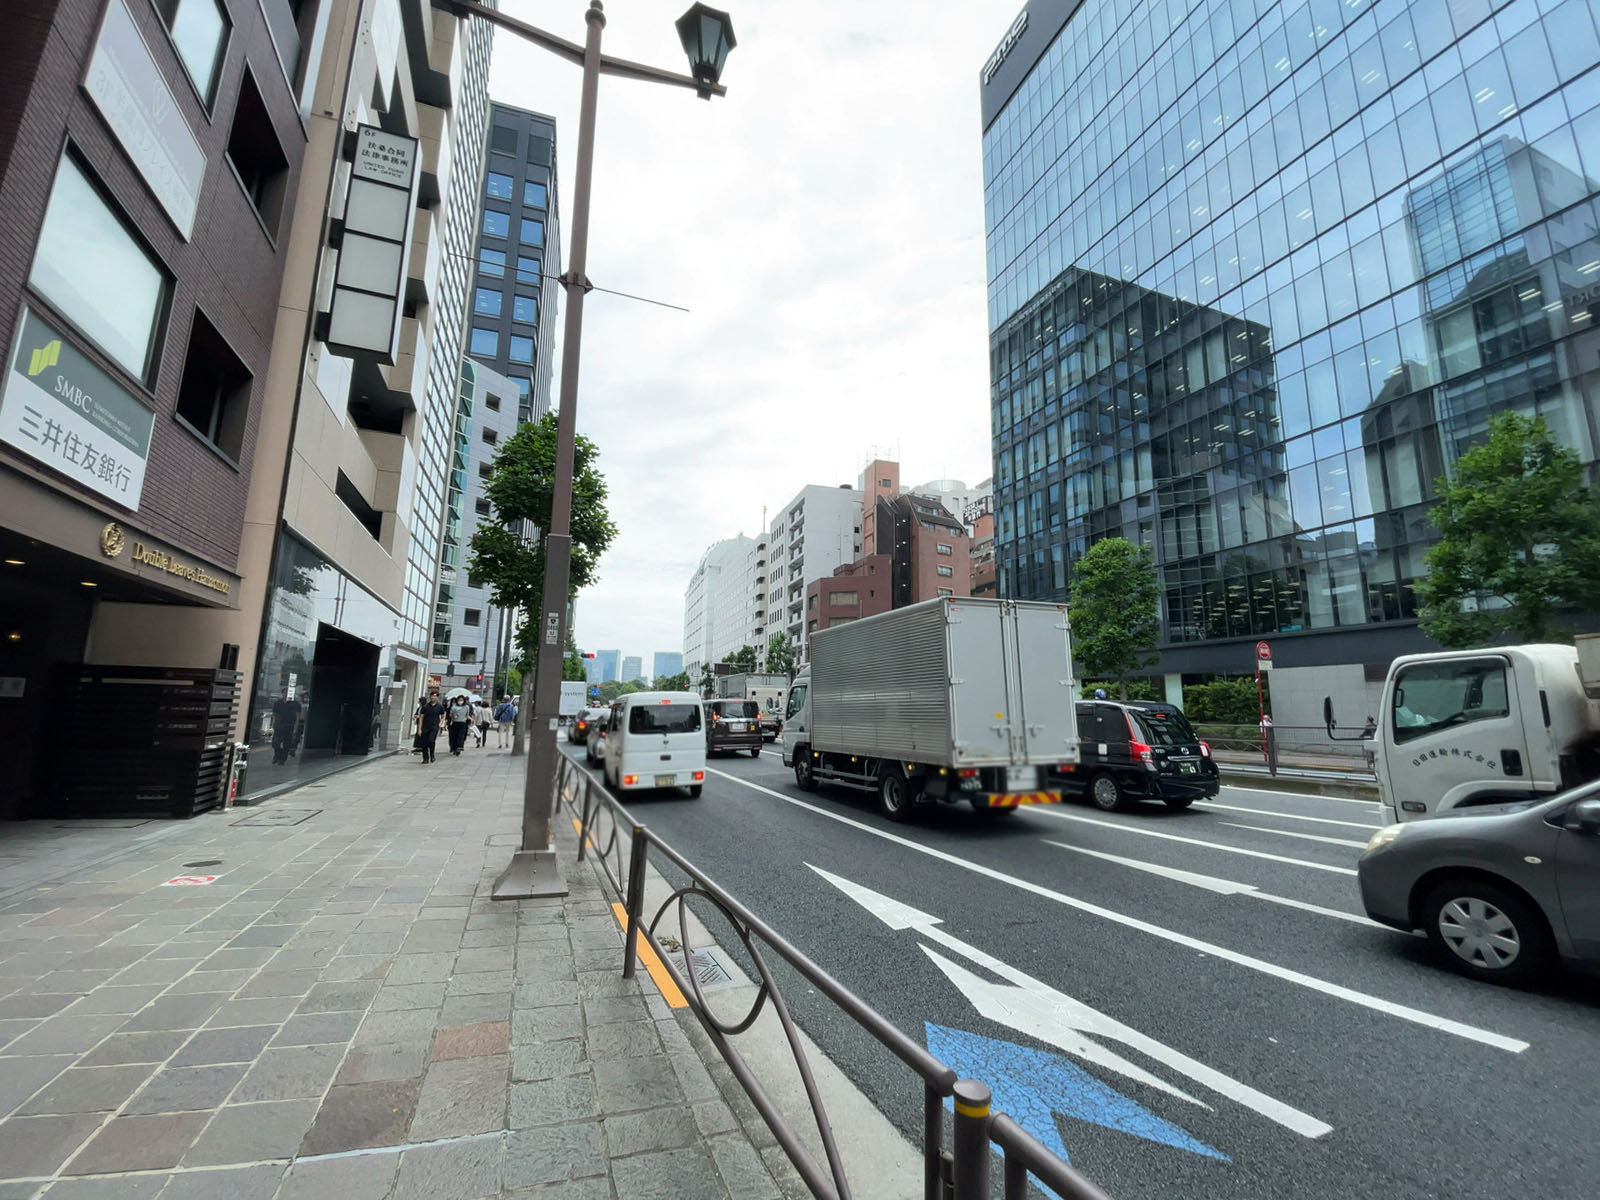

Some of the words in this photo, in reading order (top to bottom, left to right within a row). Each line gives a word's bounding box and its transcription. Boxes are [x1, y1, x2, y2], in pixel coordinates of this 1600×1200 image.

[364, 129, 376, 137] 6F
[361, 149, 409, 167] 法律事務所
[54, 375, 92, 413] SMBC
[19, 404, 132, 493] 三井住友銀行
[132, 542, 168, 570] Double
[168, 555, 195, 581] Leaves
